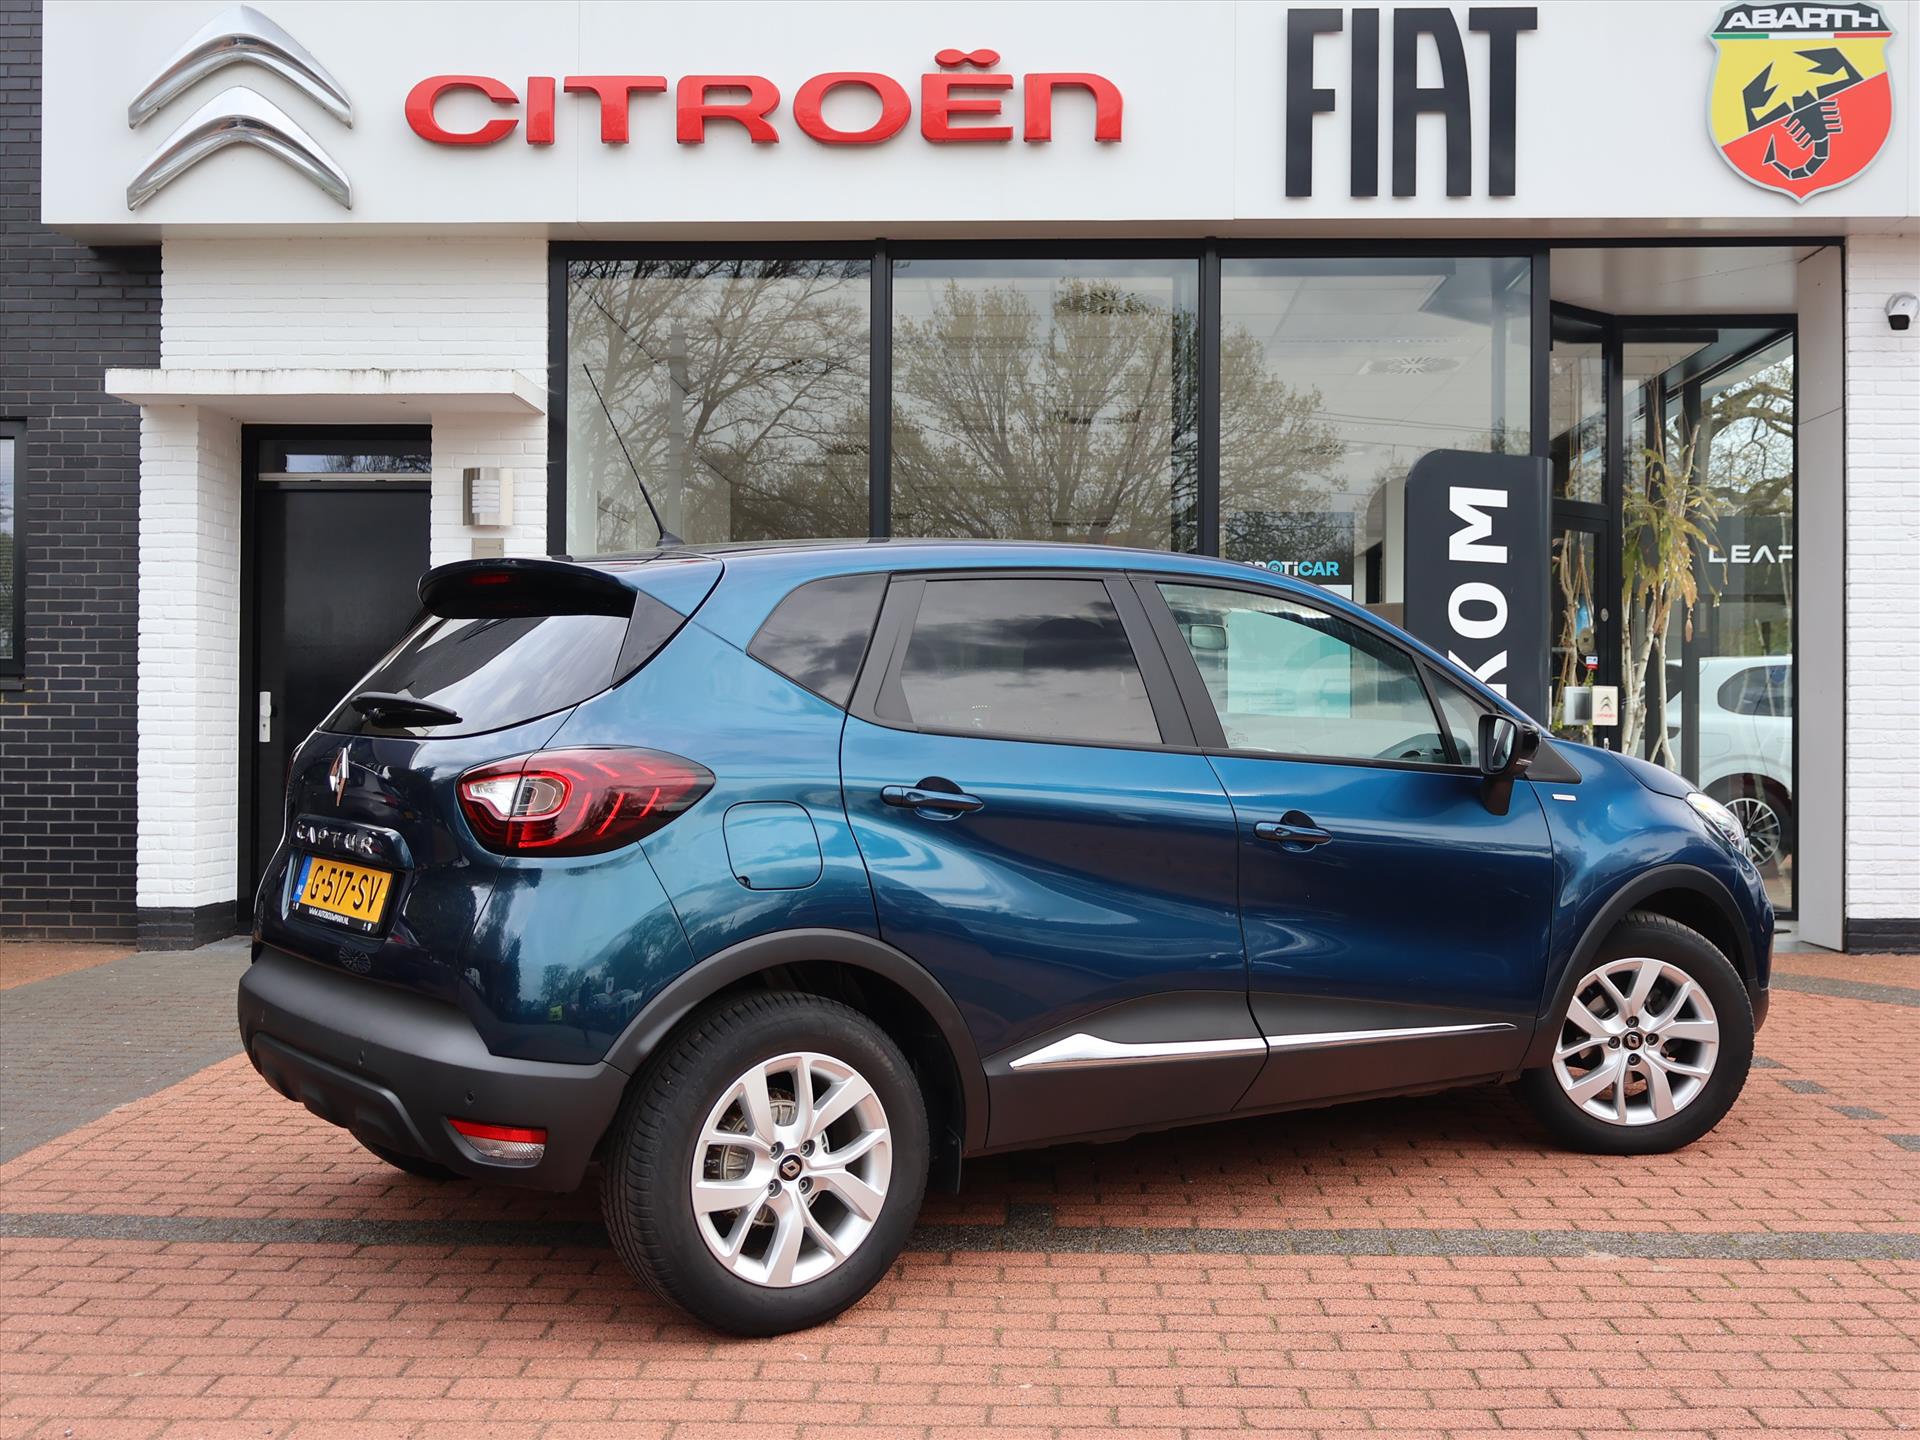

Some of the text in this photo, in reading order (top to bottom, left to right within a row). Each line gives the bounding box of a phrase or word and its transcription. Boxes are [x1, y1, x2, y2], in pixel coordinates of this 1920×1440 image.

[1724, 7, 1879, 29] ABARTH
[1286, 7, 1537, 198] FIAT
[296, 822, 373, 855] CAPTUR
[310, 865, 383, 913] G-517-SV
